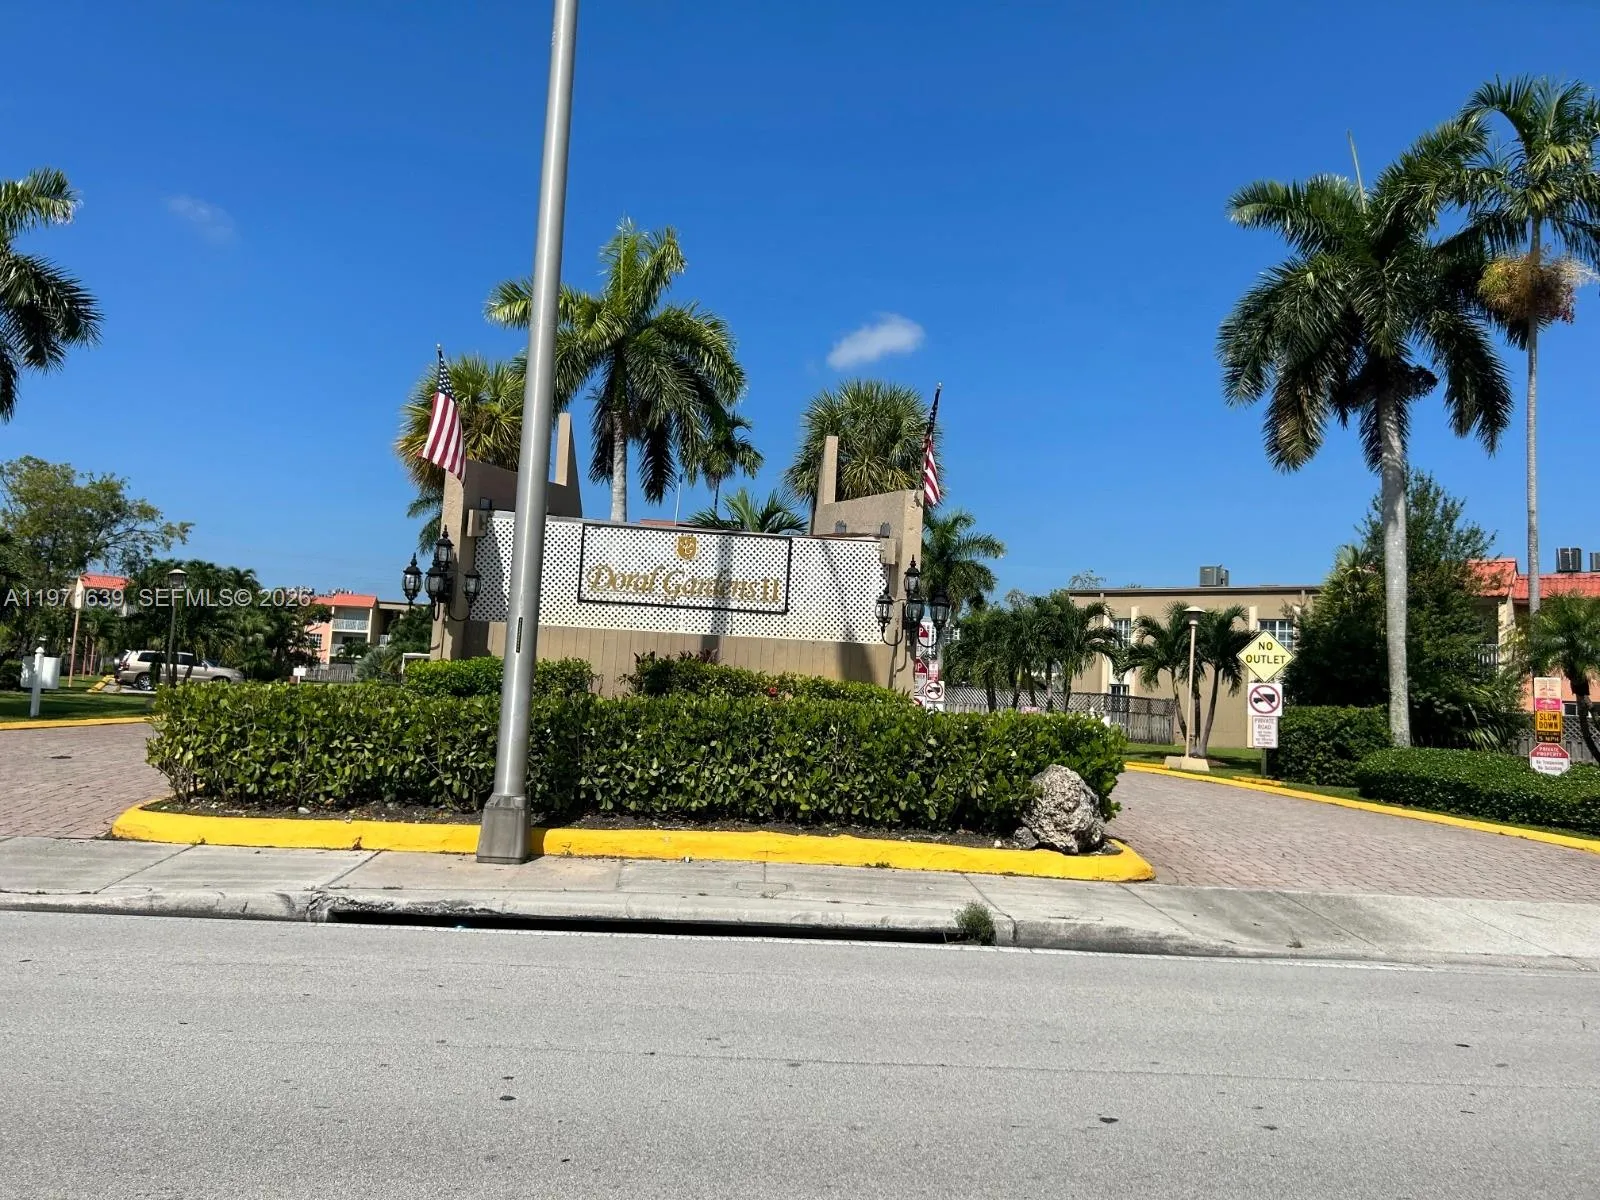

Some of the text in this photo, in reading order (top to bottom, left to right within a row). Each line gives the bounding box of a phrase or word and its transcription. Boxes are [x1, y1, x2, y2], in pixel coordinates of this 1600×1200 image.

[585, 563, 782, 602] Doral Gardens II
[1258, 642, 1273, 651] NO
[1245, 654, 1286, 664] OUTLET
[1539, 713, 1558, 721] SLOW
[1538, 721, 1559, 730] DOWN
